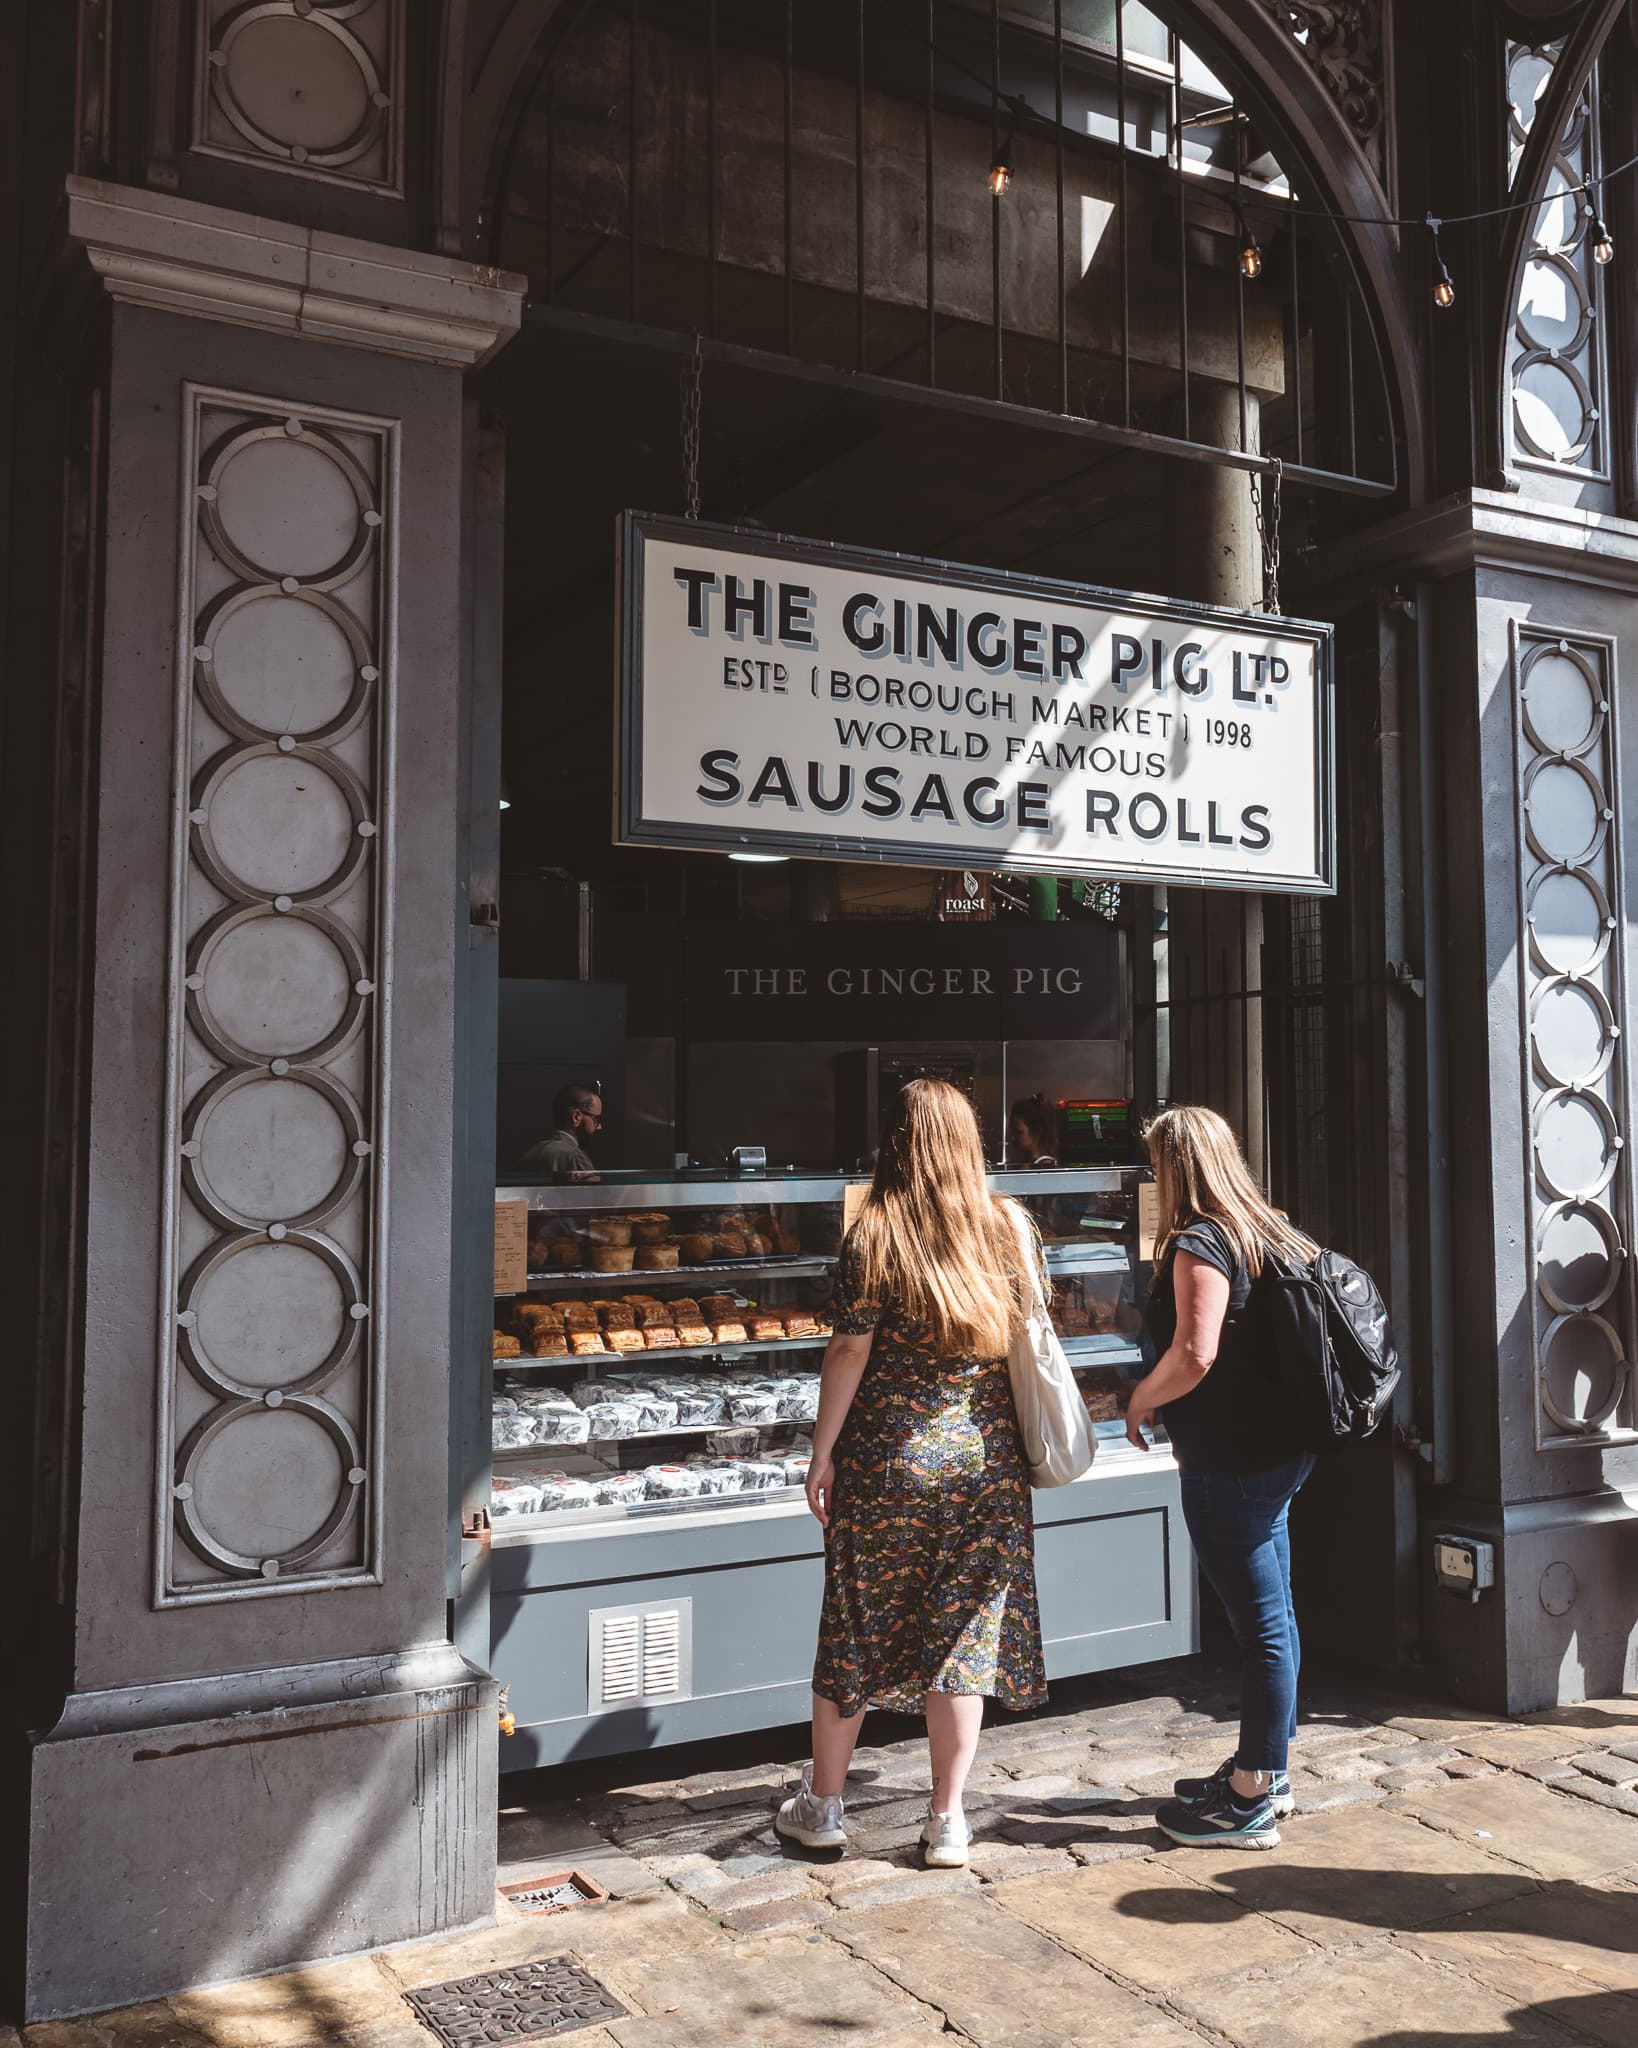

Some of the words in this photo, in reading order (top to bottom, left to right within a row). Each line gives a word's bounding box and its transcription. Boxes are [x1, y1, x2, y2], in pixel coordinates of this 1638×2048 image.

[674, 567, 817, 649] THE
[842, 592, 1088, 684] GINGER
[1111, 633, 1211, 699] PIG
[834, 718, 990, 762] WORLD
[1005, 738, 1167, 778] FAMOUS
[1205, 718, 1252, 748] 1998
[697, 750, 1052, 831] SAUSAGE
[1086, 789, 1272, 851] ROLLS
[946, 897, 986, 910] roast
[724, 968, 808, 996] THE
[827, 968, 996, 996] GINGER
[1013, 967, 1084, 996] PIG
